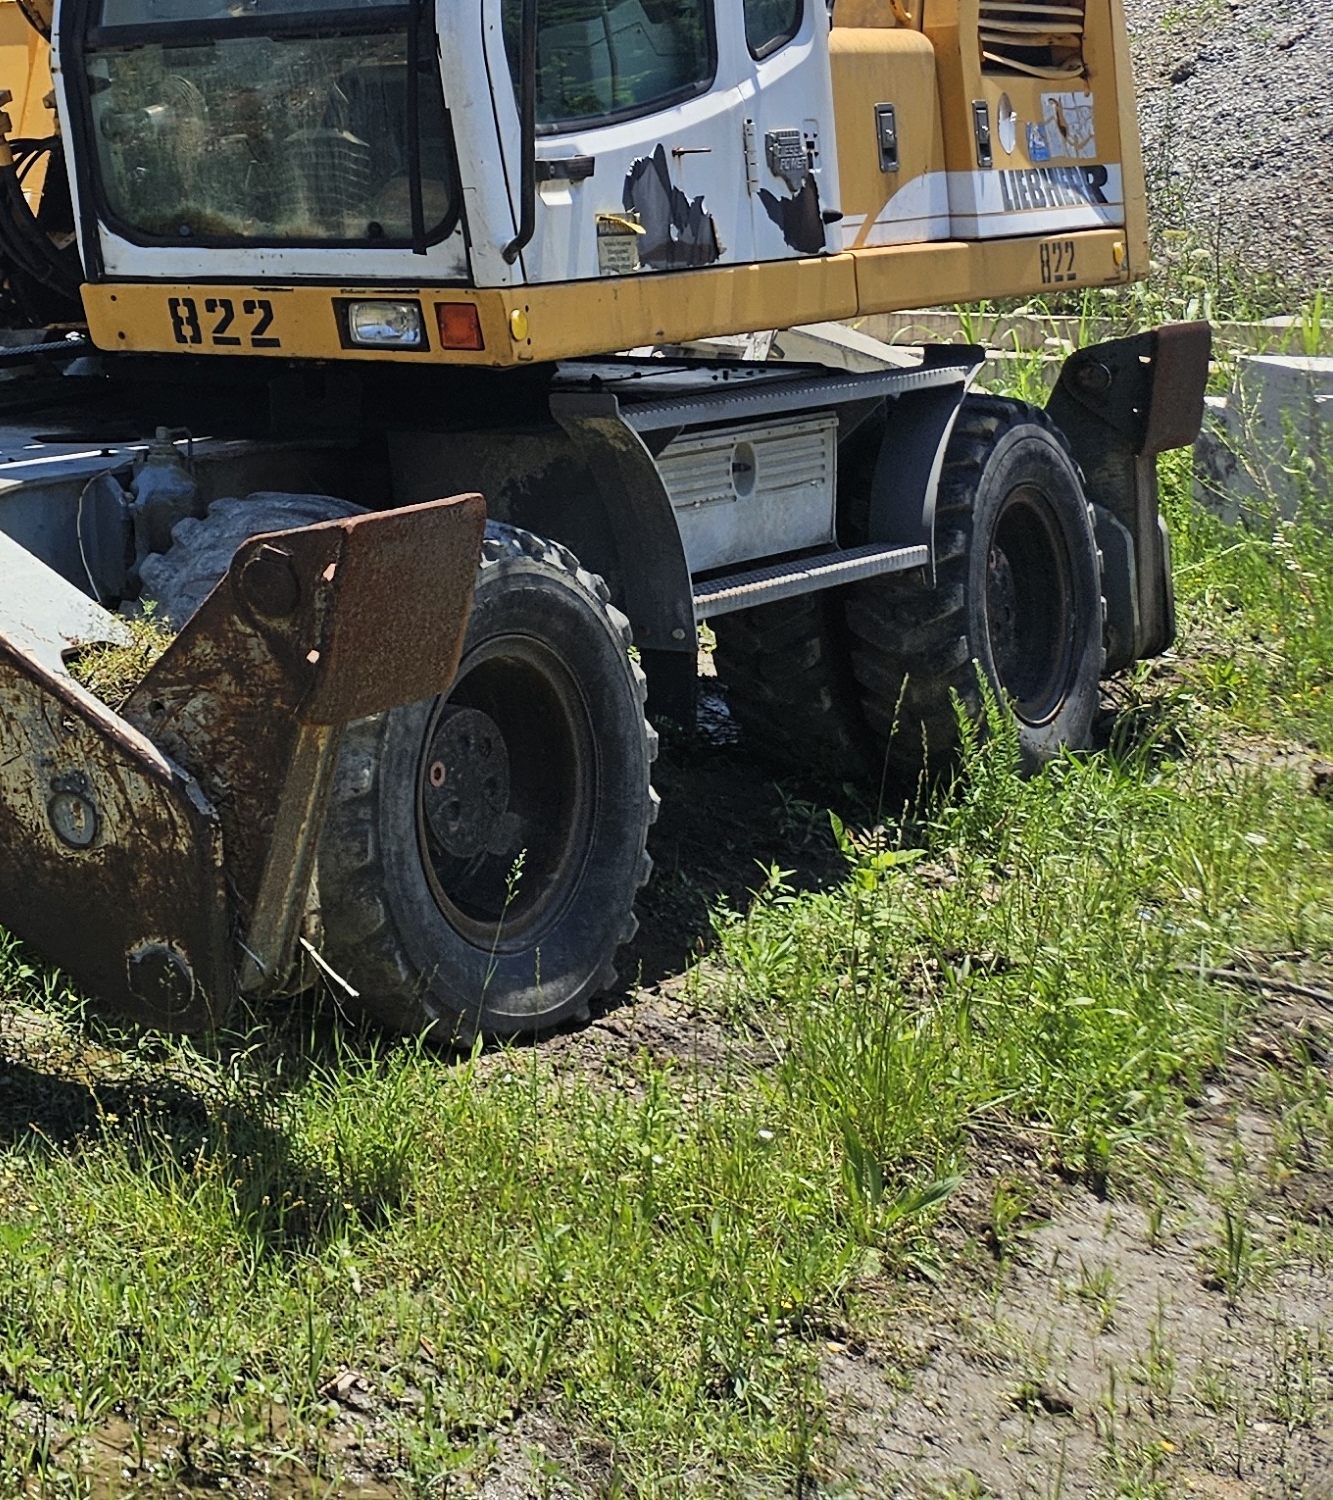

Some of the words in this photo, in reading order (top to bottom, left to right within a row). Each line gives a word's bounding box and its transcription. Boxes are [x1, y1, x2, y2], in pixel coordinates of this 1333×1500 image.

[779, 156, 808, 171] POWER
[998, 164, 1109, 210] LIEBHERR
[1040, 241, 1076, 283] 822
[168, 297, 281, 347] 822
